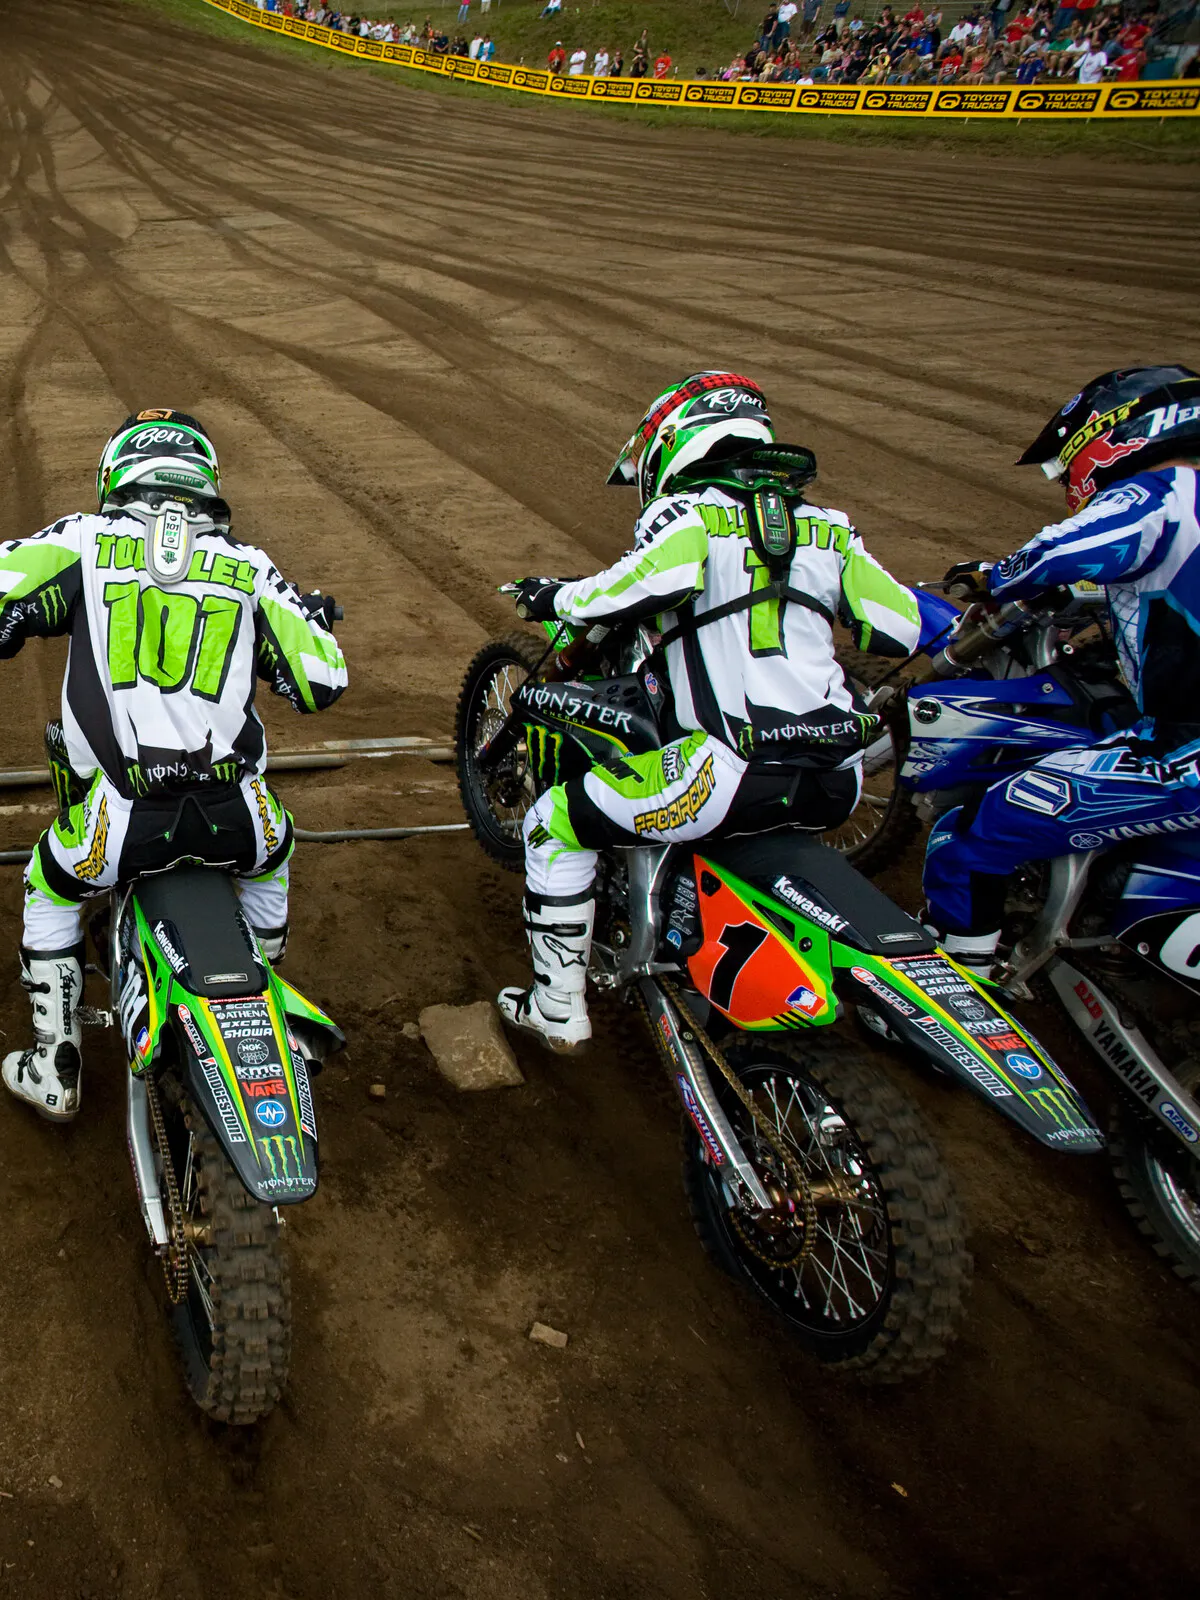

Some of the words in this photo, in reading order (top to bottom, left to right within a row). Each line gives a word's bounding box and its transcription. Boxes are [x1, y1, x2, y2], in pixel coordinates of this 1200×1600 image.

[652, 91, 679, 99] TRUCKS
[705, 88, 734, 96] TOYOTA
[760, 90, 793, 98] TOYOTA
[821, 92, 857, 100] TOYOTA
[889, 93, 928, 101] TOYOTA
[964, 93, 1006, 101] TOYOTA
[1048, 92, 1097, 101] TOYOTA
[703, 94, 732, 102] TRUCKS
[758, 96, 791, 105] TRUCKS
[819, 99, 855, 107] TRUCKS
[887, 101, 926, 109] TRUCKS
[961, 102, 1004, 110] TRUCKS
[1044, 101, 1093, 110] TRUCKS
[703, 388, 768, 412] Ryan
[130, 427, 195, 450] Ben
[154, 471, 208, 489] TOWNLEY
[767, 497, 776, 509] 1
[165, 522, 179, 532] 101
[103, 579, 241, 704] 101
[773, 875, 849, 932] Kawasaki
[153, 920, 190, 974] Kawasaki
[708, 920, 770, 1013] 1
[908, 959, 949, 968] SCOTT
[916, 967, 957, 977] ATHENA
[917, 976, 965, 986] EXCEL
[926, 983, 975, 996] SHOWA
[226, 1009, 269, 1019] ATHENA
[220, 1020, 271, 1028] EXCEL
[223, 1028, 273, 1039] SHOWA
[242, 1043, 262, 1051] NGK
[909, 1015, 1014, 1098] BRIDGESTONE
[1092, 1020, 1161, 1104] YAMAHA
[241, 1081, 288, 1097] VANS
[200, 1057, 246, 1143] BRIDGESTONE
[290, 1051, 318, 1143] BRIDGESTONE
[1165, 1107, 1195, 1140] AFAM
